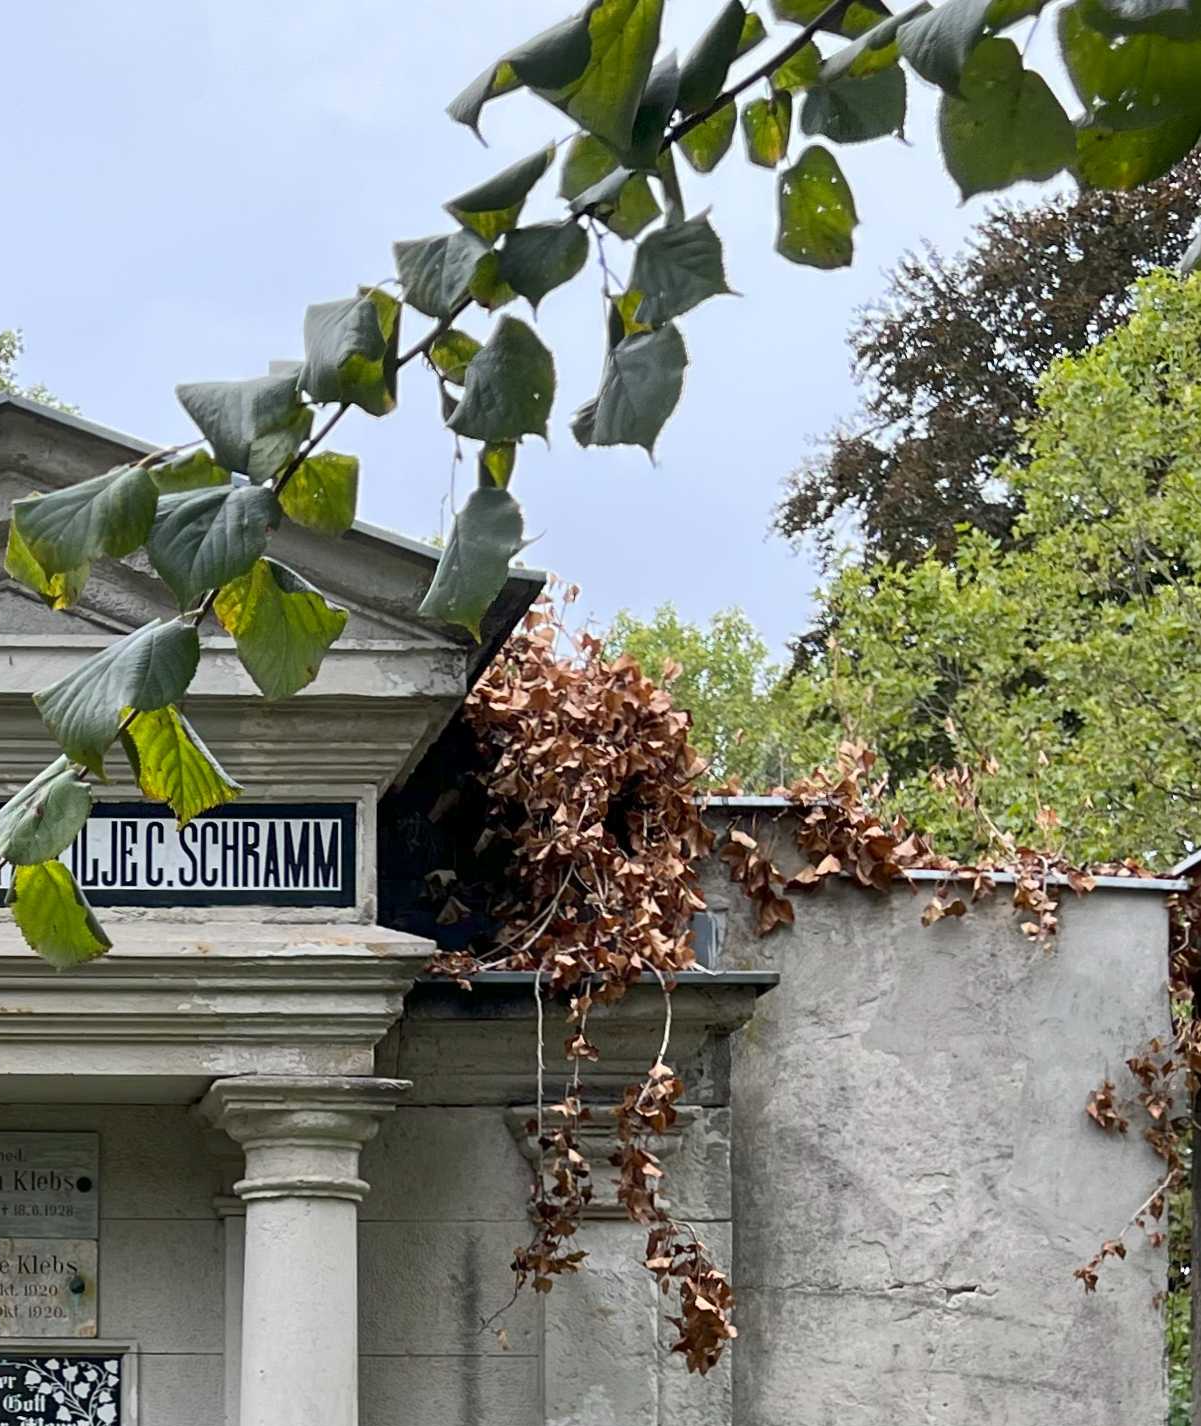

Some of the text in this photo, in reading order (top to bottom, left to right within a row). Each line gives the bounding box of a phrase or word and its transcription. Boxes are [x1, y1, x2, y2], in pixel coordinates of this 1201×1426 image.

[178, 820, 340, 889] SCHRAMM
[13, 1170, 74, 1192] Klebs
[17, 1254, 79, 1276] Klebs
[2, 1393, 47, 1414] Gott
